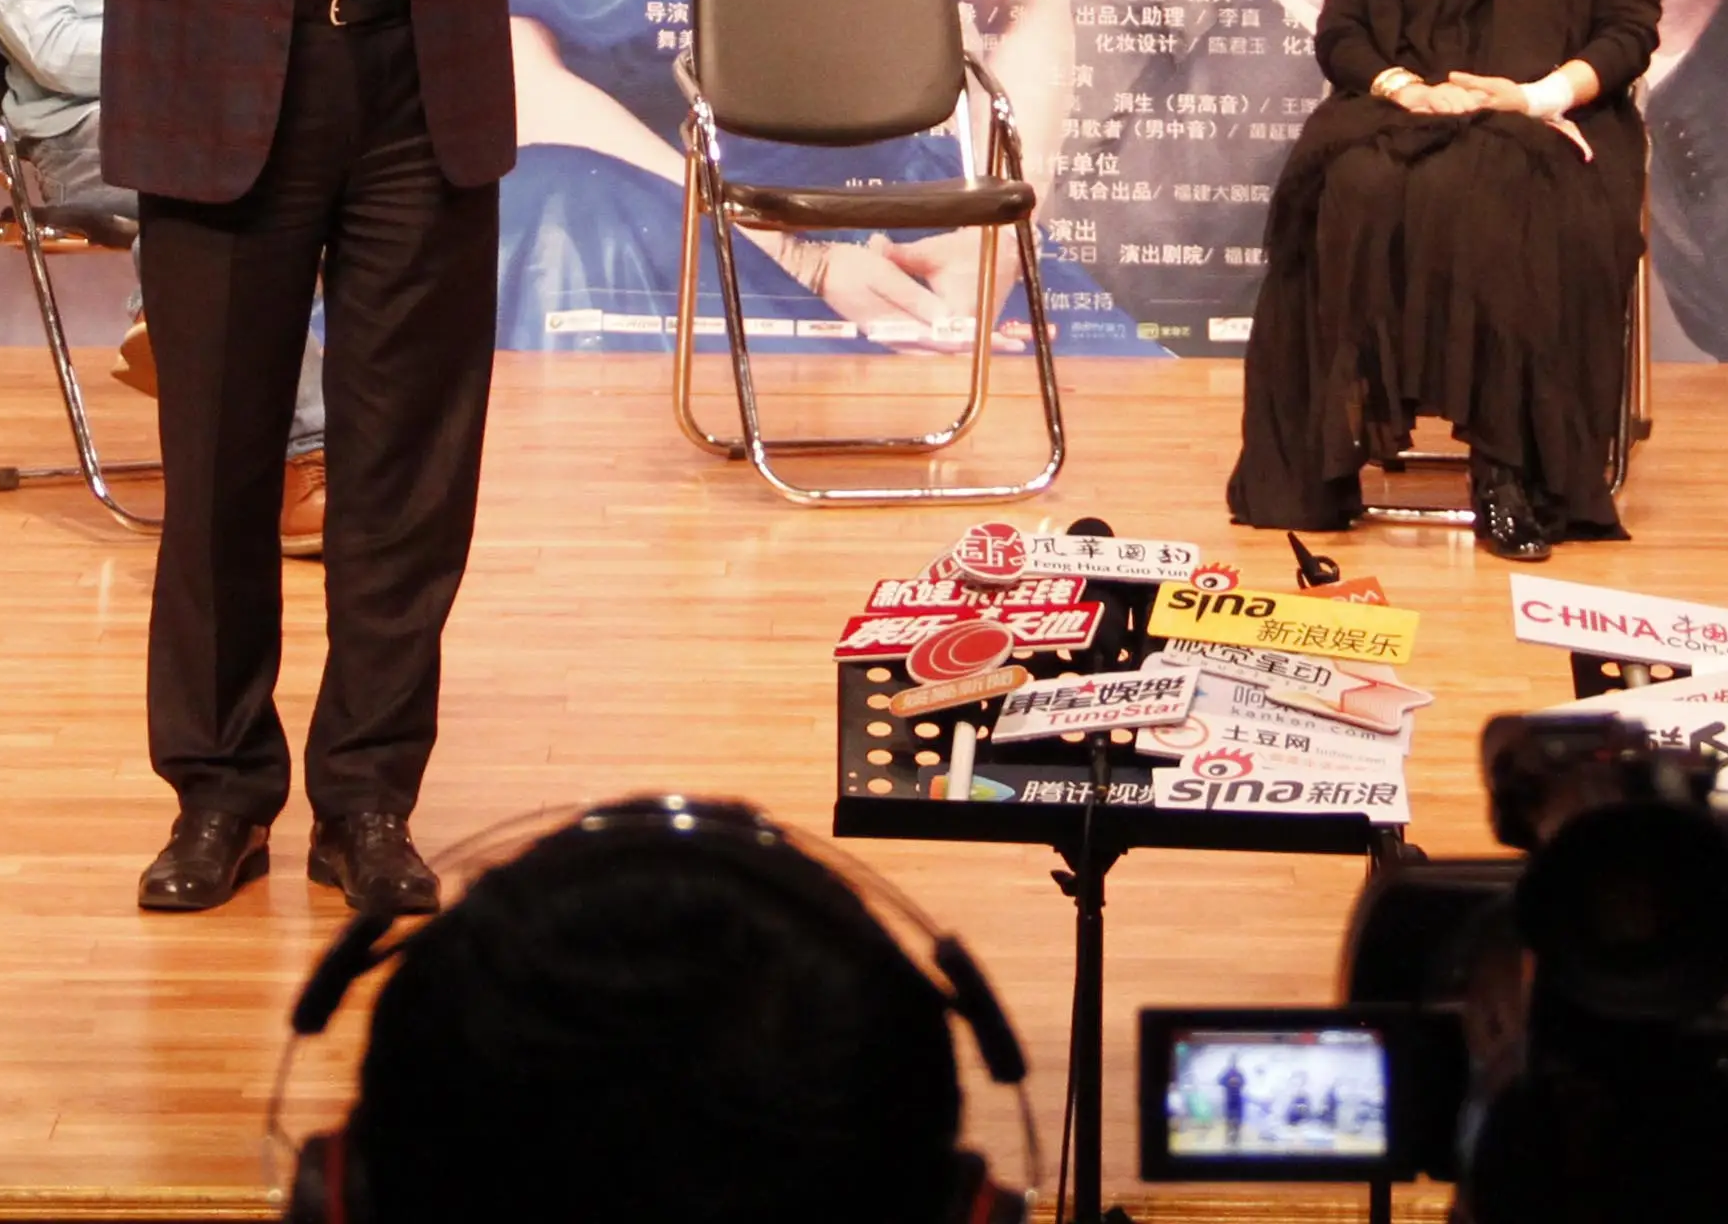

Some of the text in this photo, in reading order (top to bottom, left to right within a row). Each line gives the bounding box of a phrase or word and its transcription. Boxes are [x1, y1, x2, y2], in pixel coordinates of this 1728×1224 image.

[1076, 5, 1185, 28] 出品人助理
[1224, 247, 1268, 265] 福建
[1033, 559, 1189, 577] Feng Hua Guo Yun
[1167, 588, 1277, 623] sina
[1521, 600, 1663, 644] CHINA
[1255, 618, 1404, 658] 新浪娱乐
[1046, 701, 1185, 726] TungStar
[1222, 725, 1312, 753] 土豆网
[1168, 779, 1399, 810] sina 新浪
